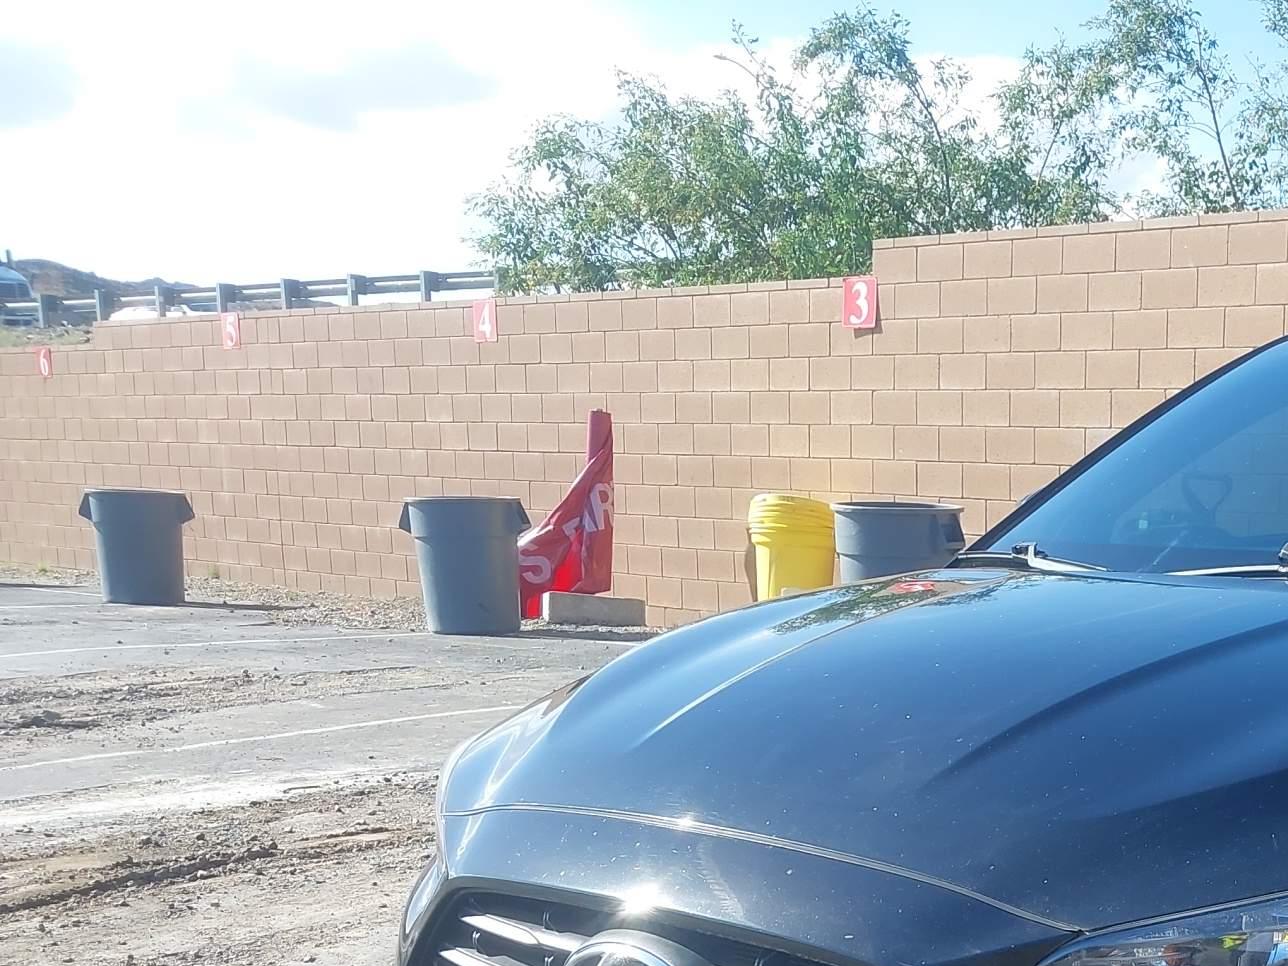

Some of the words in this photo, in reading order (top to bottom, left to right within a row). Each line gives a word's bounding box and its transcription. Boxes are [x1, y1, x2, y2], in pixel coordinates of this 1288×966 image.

[849, 281, 869, 324] 3
[225, 315, 237, 347] 5
[478, 305, 492, 340] 4
[40, 350, 49, 376] 6
